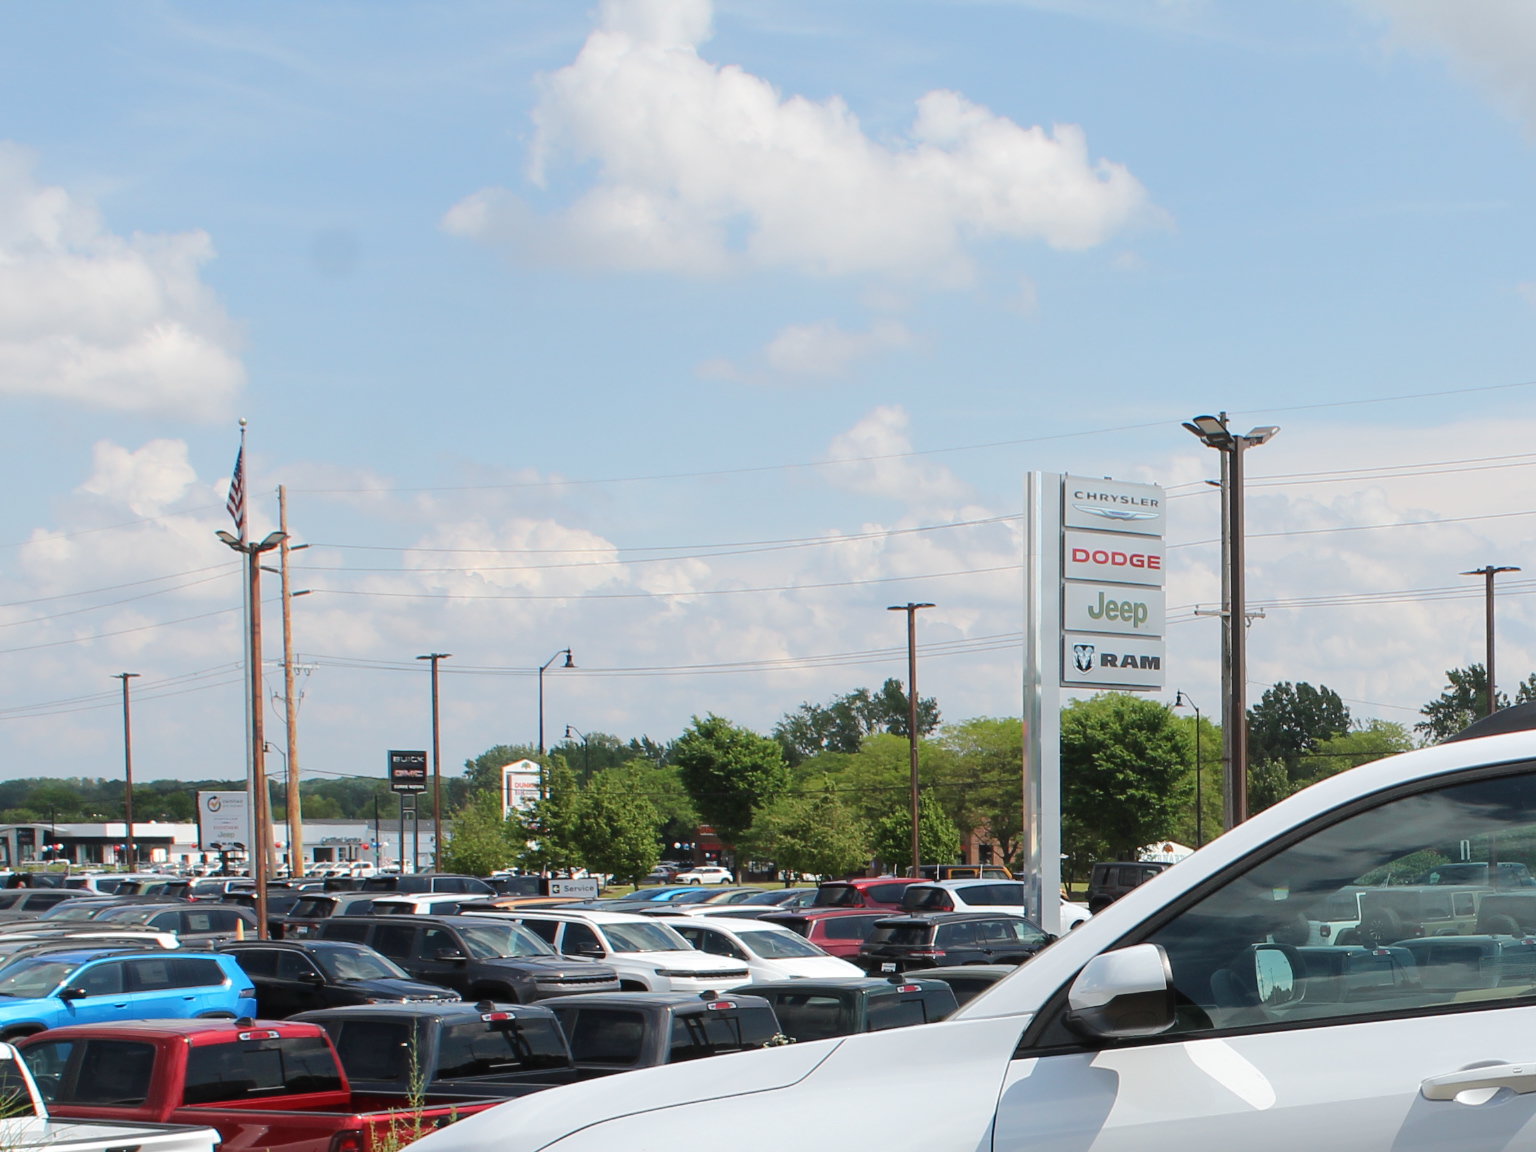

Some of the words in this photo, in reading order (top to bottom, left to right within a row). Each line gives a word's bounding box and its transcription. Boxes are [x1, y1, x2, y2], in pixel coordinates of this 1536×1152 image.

[1074, 490, 1159, 508] CHRYSLER
[1072, 548, 1161, 570] DODGE
[1087, 591, 1148, 628] Jeep
[1100, 653, 1161, 670] RAM
[394, 769, 424, 777] GMC
